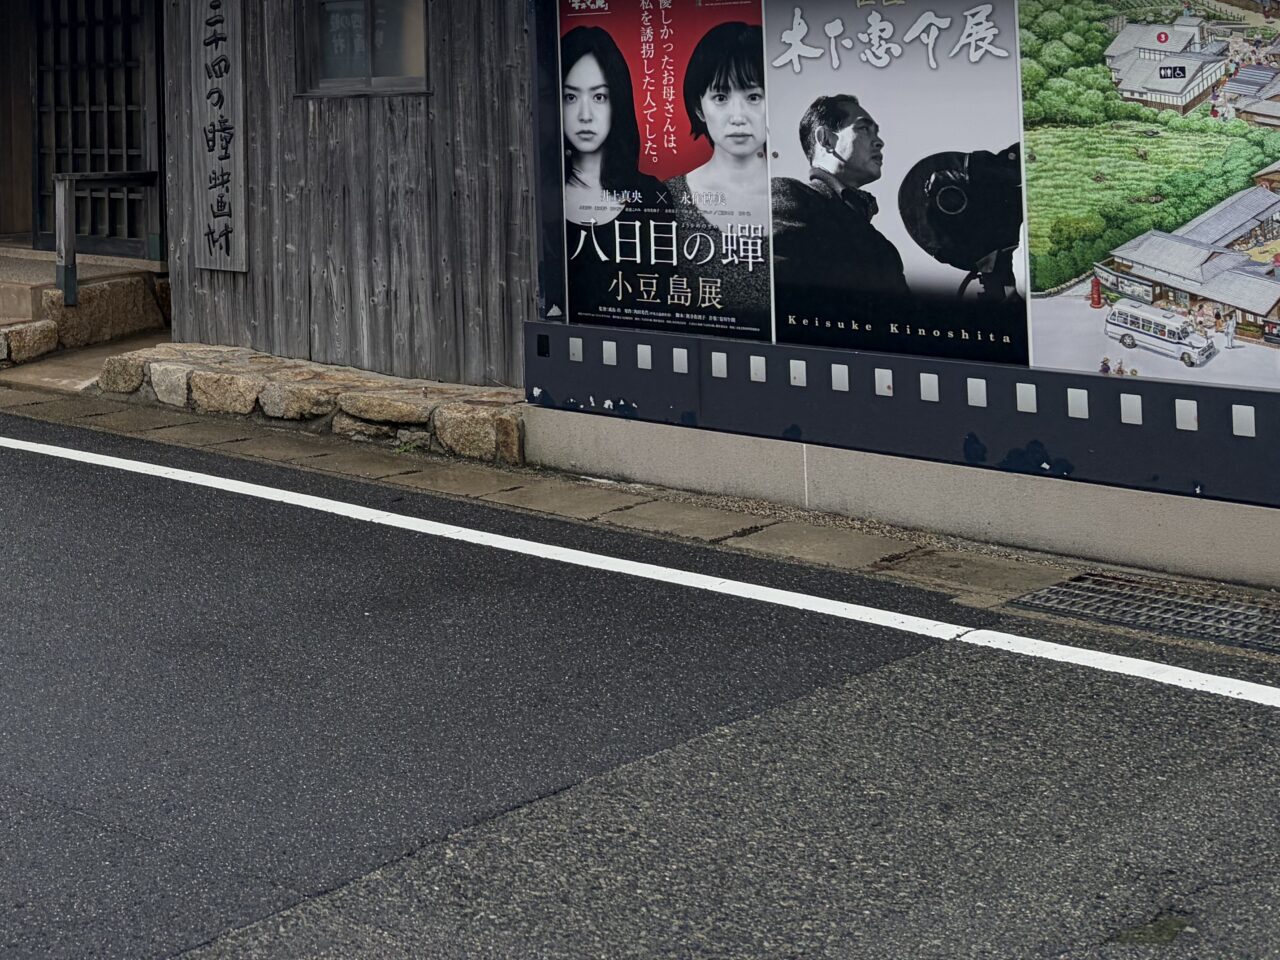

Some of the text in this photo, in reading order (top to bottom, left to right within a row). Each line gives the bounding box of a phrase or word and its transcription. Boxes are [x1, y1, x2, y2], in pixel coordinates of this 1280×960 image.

[607, 270, 724, 309] 小豆島展
[788, 315, 1011, 344] Keisuke Kinoshita
